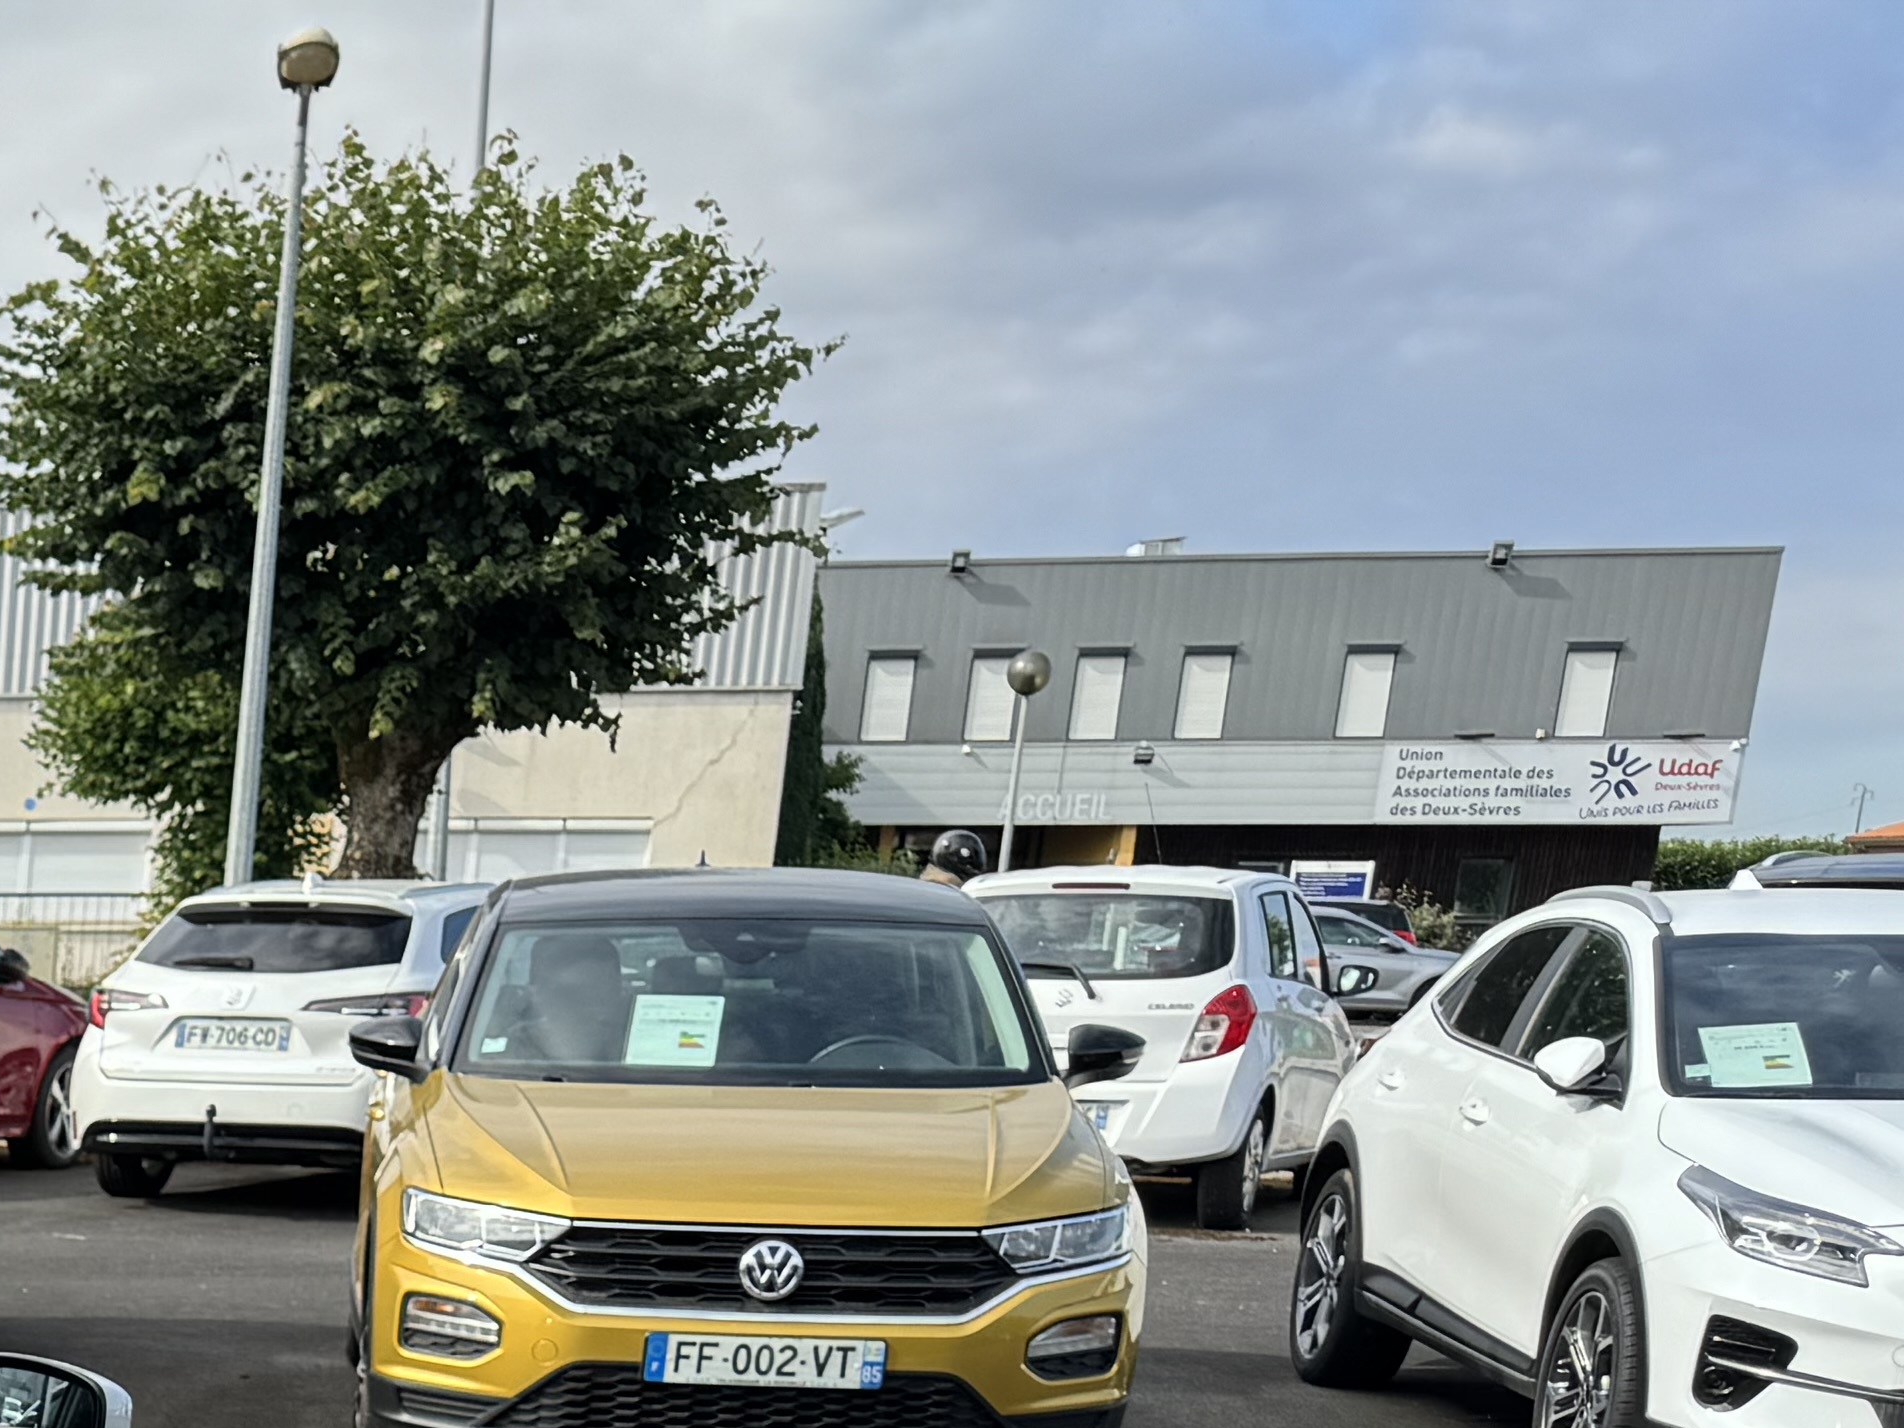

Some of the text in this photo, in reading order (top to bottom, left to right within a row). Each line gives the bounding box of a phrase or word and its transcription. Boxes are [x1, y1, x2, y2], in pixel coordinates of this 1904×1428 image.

[1399, 748, 1443, 761] Union
[1396, 766, 1554, 782] Départementale des
[1658, 758, 1724, 779] Udaf
[1392, 785, 1572, 798] Associations familiales
[1390, 802, 1522, 816] des Deux-Sèvres
[673, 1341, 856, 1378] FF-002-VT
[861, 1364, 882, 1384] 85
